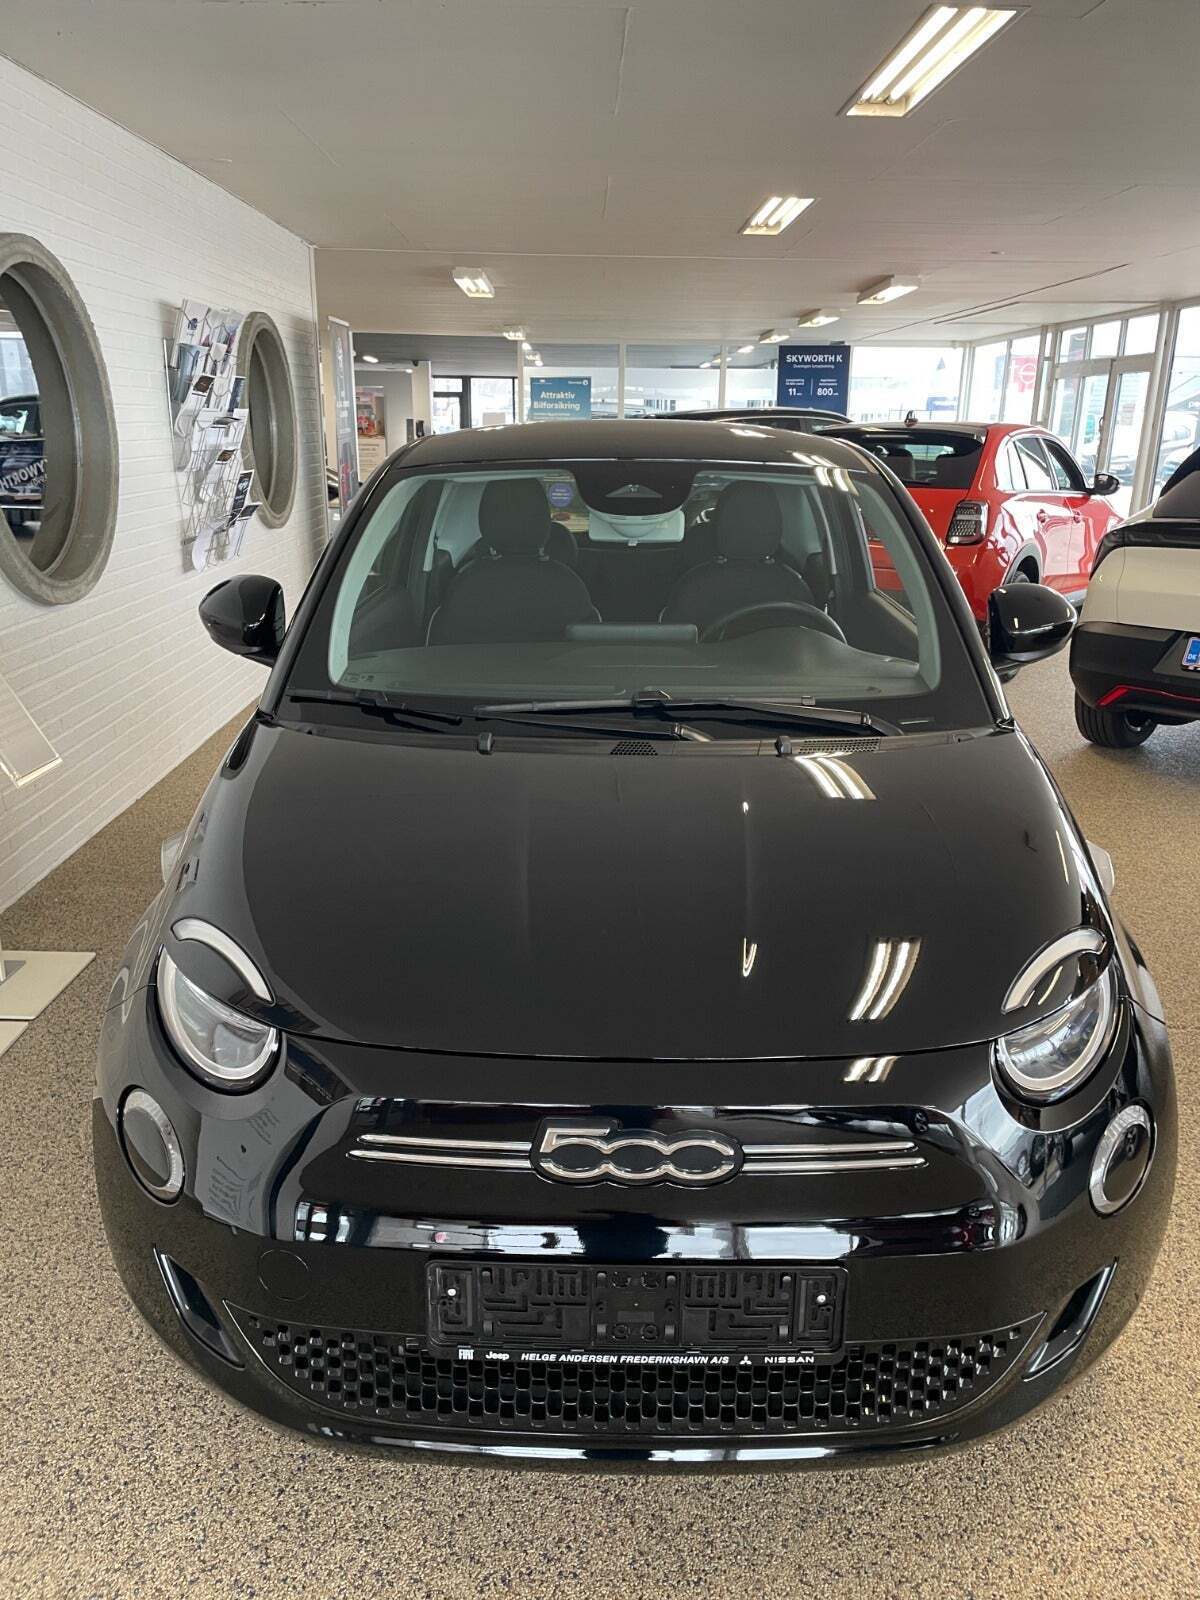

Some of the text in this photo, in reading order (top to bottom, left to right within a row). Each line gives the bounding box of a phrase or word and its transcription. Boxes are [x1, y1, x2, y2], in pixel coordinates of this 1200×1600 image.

[786, 354, 843, 363] SKYWORTH K
[540, 391, 576, 399] Attraktiv
[788, 388, 797, 396] 11
[817, 387, 833, 396] 800
[533, 401, 581, 411] Bilforsikring
[539, 1127, 736, 1180] 500
[458, 1348, 815, 1365] FIAT Jeep HELGE ANDERSEN FREDERIKSHAVN A/S NISSAN
